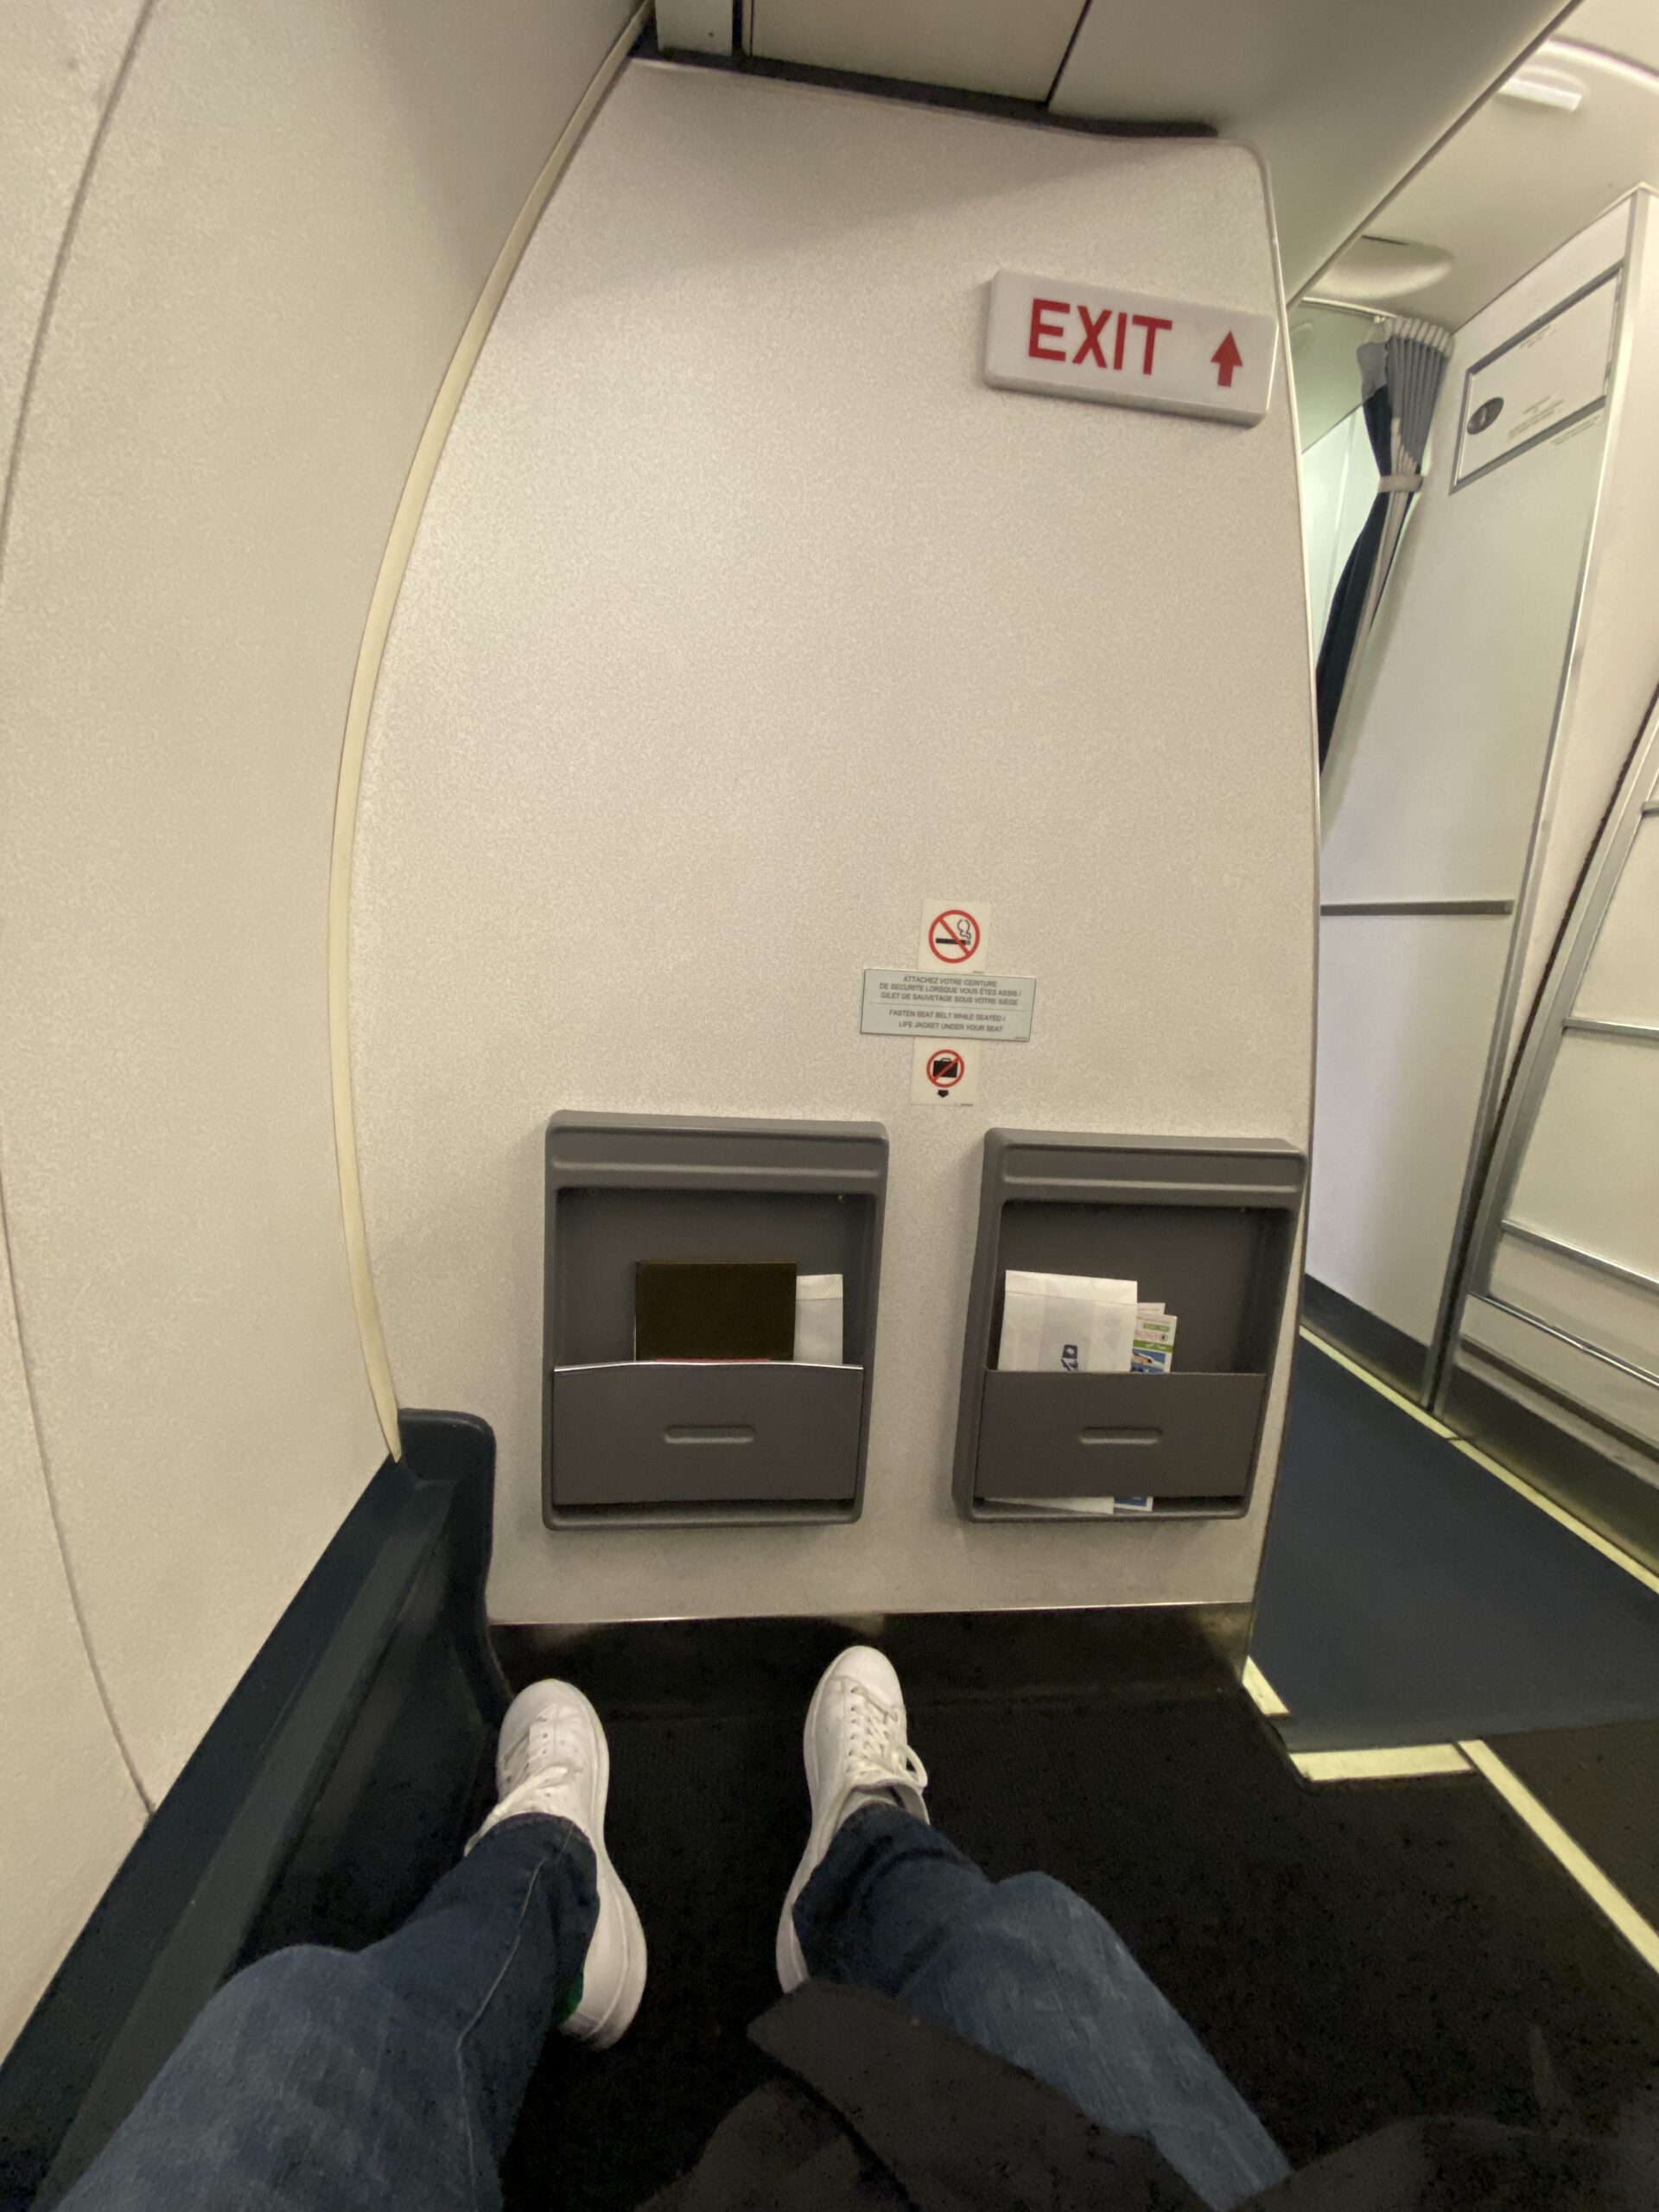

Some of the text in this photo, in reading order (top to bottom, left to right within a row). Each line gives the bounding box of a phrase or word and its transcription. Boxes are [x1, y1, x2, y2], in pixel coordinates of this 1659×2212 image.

[1028, 297, 1173, 376] EXIT
[903, 976, 938, 984] ATTACHEZ
[963, 979, 997, 988] CEINTURE
